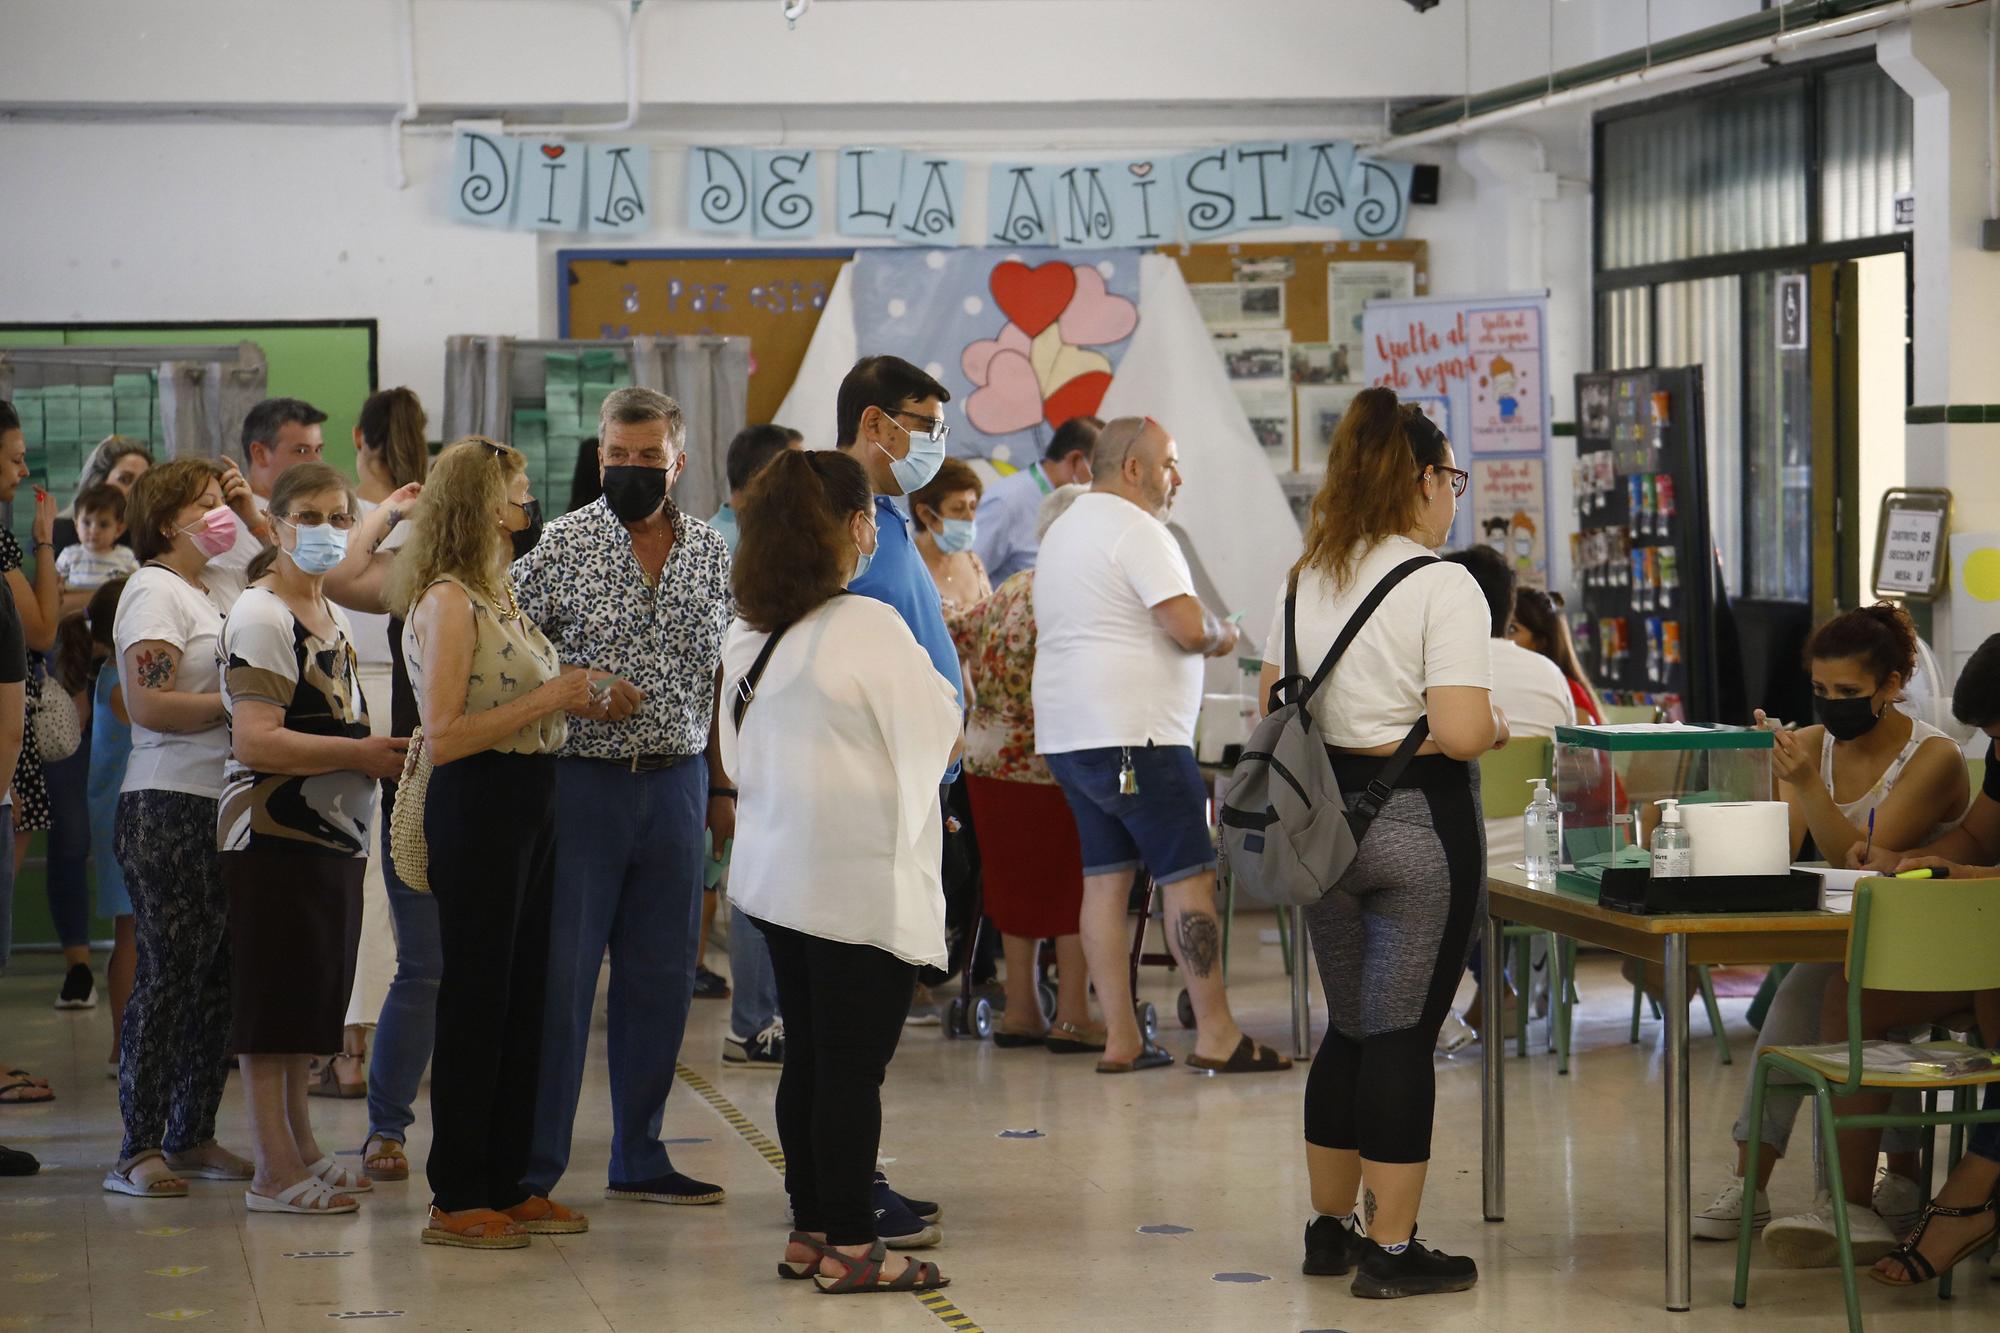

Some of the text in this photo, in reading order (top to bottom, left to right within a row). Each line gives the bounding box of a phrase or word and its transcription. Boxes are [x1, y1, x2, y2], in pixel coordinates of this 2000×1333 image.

[695, 146, 813, 230] DE
[846, 150, 954, 237] LA
[993, 142, 1401, 244] AMISTAD
